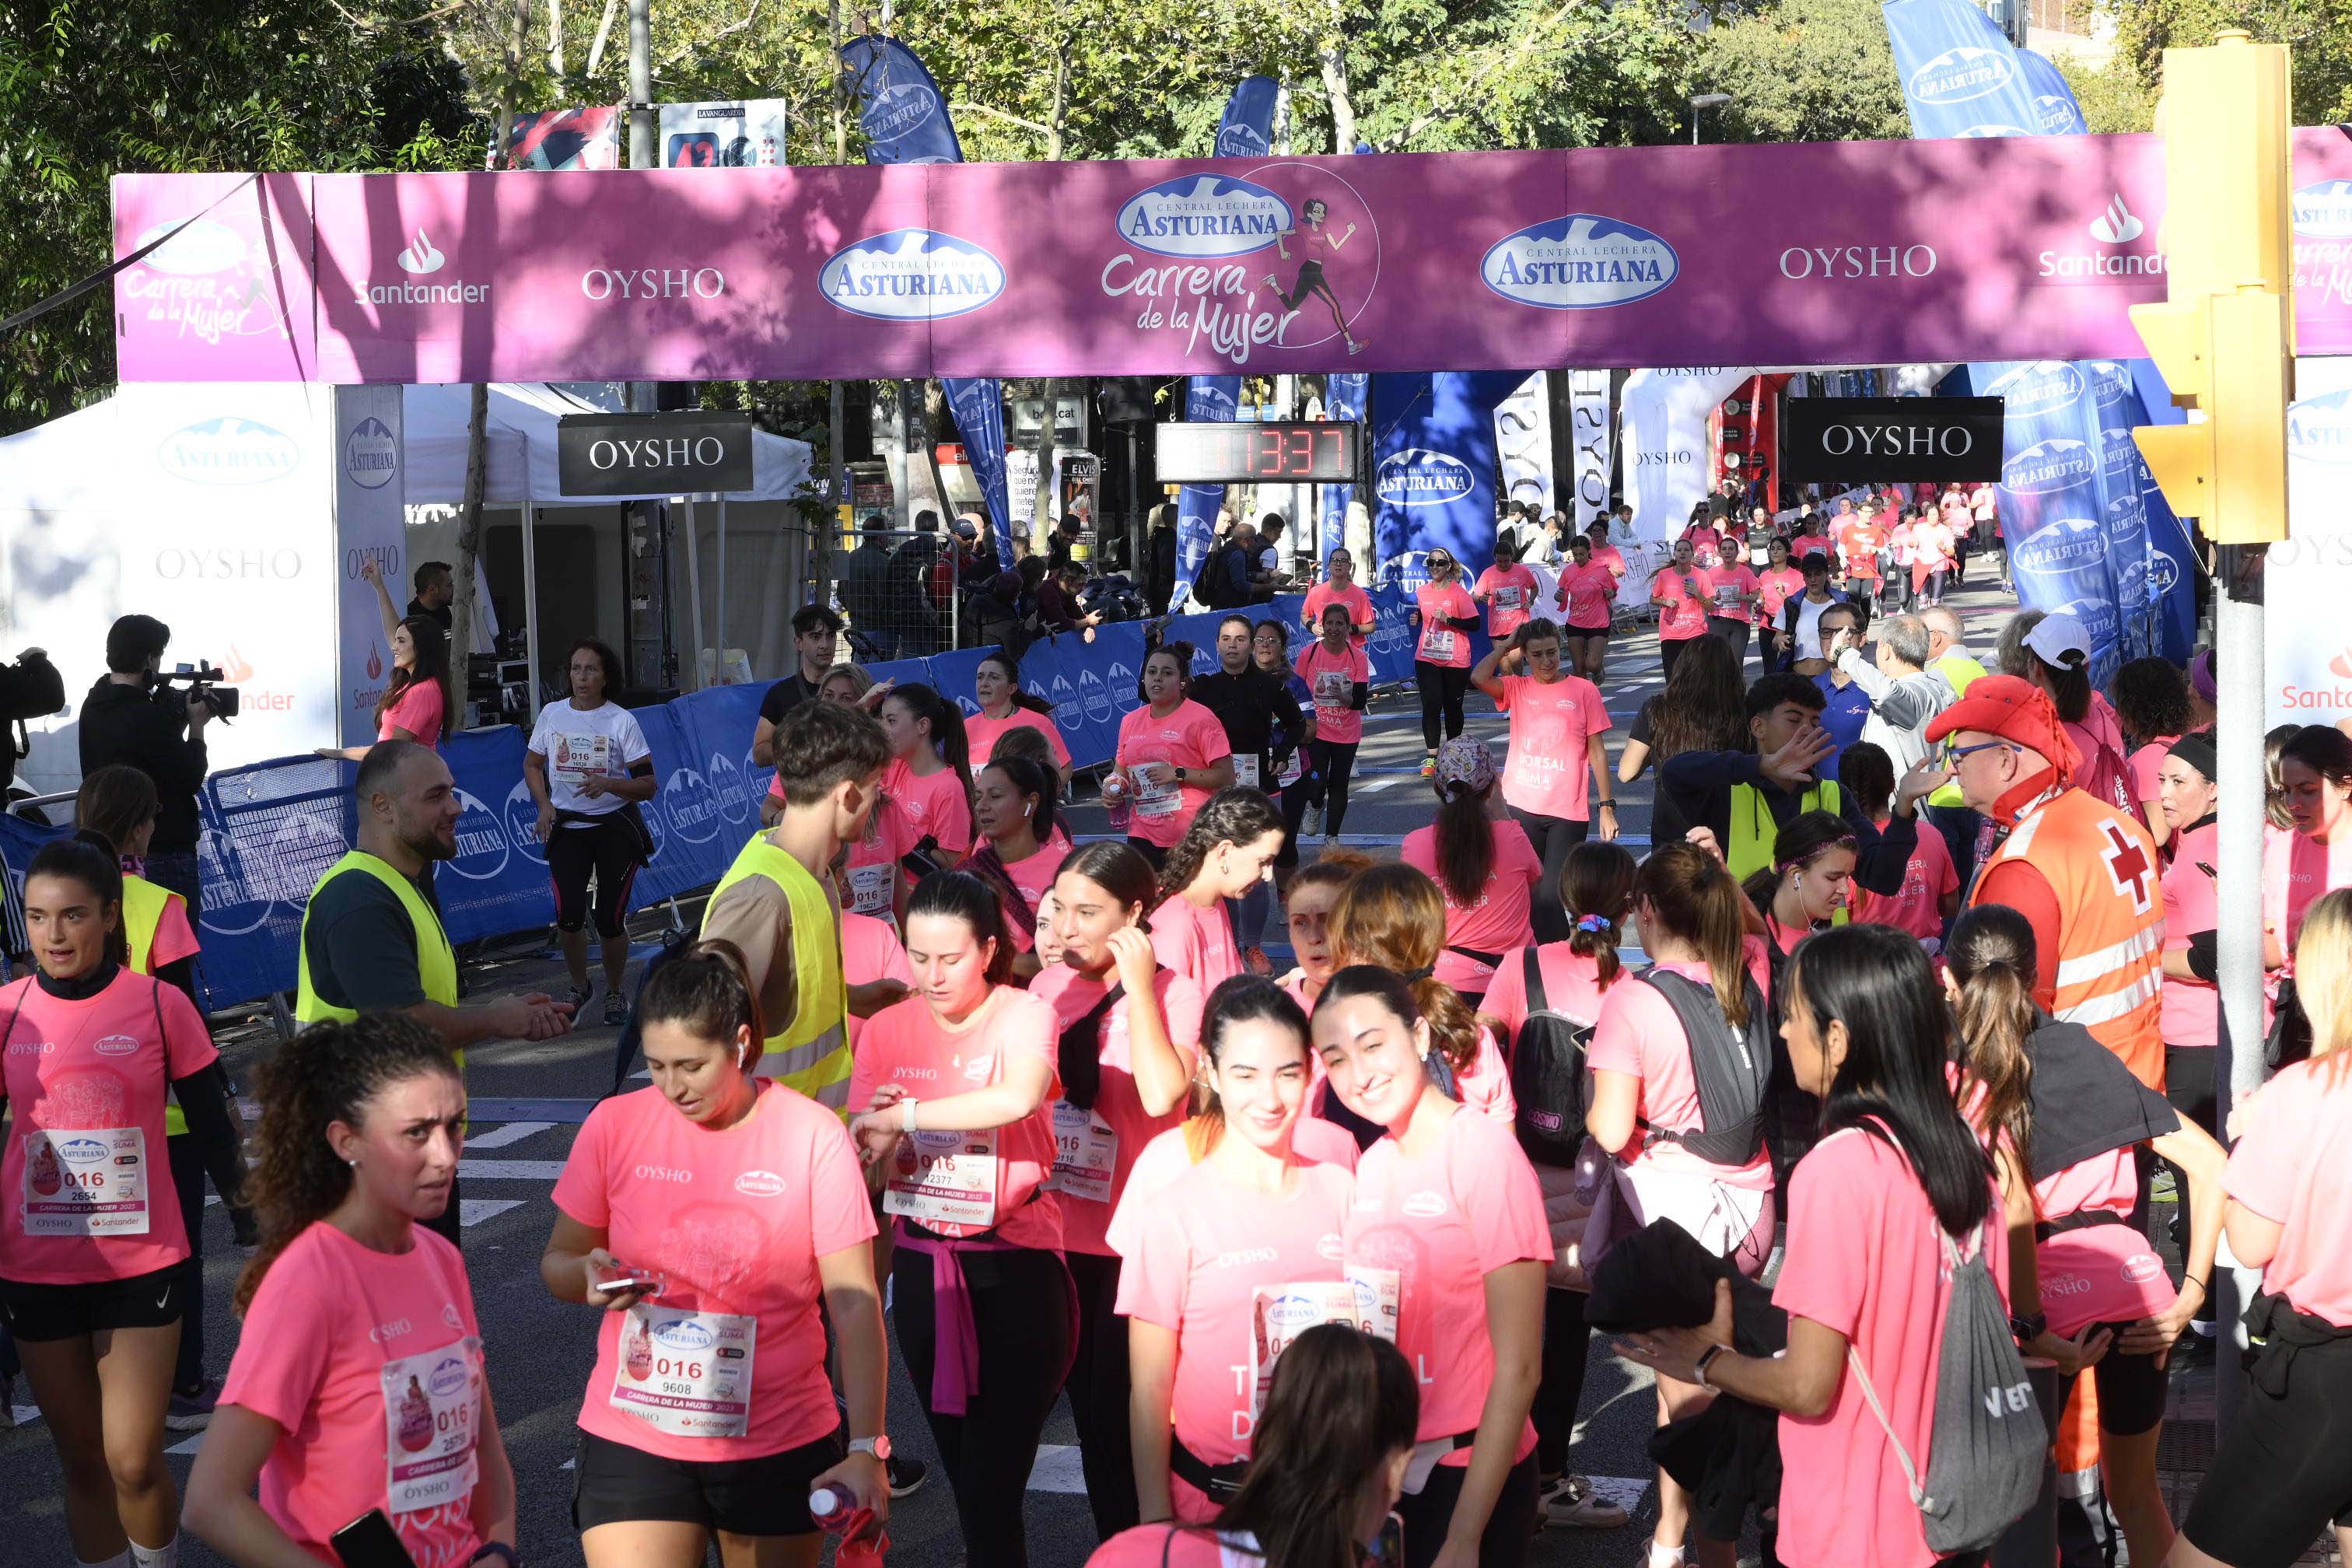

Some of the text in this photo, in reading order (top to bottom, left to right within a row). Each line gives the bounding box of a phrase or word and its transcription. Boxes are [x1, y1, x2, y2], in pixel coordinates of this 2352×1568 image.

[1157, 201, 1274, 212] CENTRAL LECHERA
[1129, 205, 1278, 237] ASTURIANA
[1526, 244, 1657, 257] CENTRAL LECHERA
[862, 261, 920, 270] CENTRAL
[1496, 250, 1664, 285] ASTURIANA
[1780, 244, 1937, 280] OYSHO
[2039, 250, 2170, 277] Santand
[582, 268, 725, 300] OYSHO
[832, 262, 992, 297] ASTURIANA
[1101, 254, 1247, 296] Carrera
[355, 281, 490, 304] Santander
[1137, 292, 1301, 364] de la Mujer
[1822, 425, 1973, 457] OYSHO
[349, 445, 394, 472] ASTURIANA
[589, 436, 723, 471] OYSHO
[1072, 465, 1097, 474] ELVIS
[1423, 467, 1464, 475] LECHERA
[1378, 474, 1467, 493] ASTURIANA
[155, 548, 303, 580] OYSHO
[347, 544, 398, 582] OHO
[241, 690, 296, 710] nder
[1909, 873, 1922, 884] LA
[856, 890, 878, 902] 016
[1444, 895, 1489, 909] MUER
[10, 1041, 136, 1055] OYSHO ASTURIANA
[61, 1141, 137, 1158] ASTURIANA SUMA
[921, 1154, 956, 1171] 016
[64, 1171, 104, 1187] 016
[635, 1165, 782, 1191] OYSHO ASTURIANA
[926, 1174, 952, 1185] 12377
[72, 1192, 97, 1201] 2654
[944, 1190, 966, 1199] MUJER
[950, 1206, 985, 1216] Santander
[37, 1218, 139, 1227] OYSHO Santander
[1218, 1246, 1278, 1268] OYSHO
[657, 1330, 745, 1346] ASTURIANA SUMA
[657, 1358, 703, 1379] 016
[1417, 1354, 1433, 1384] L
[663, 1381, 691, 1395] 9608
[1230, 1365, 1248, 1395] T
[627, 1391, 660, 1405] CARRERA
[661, 1398, 673, 1406] DE
[674, 1399, 684, 1408] LA
[685, 1402, 713, 1410] MUJER
[437, 1402, 467, 1433] 016
[692, 1417, 736, 1429] Santander
[404, 1480, 450, 1500] OYSHO
